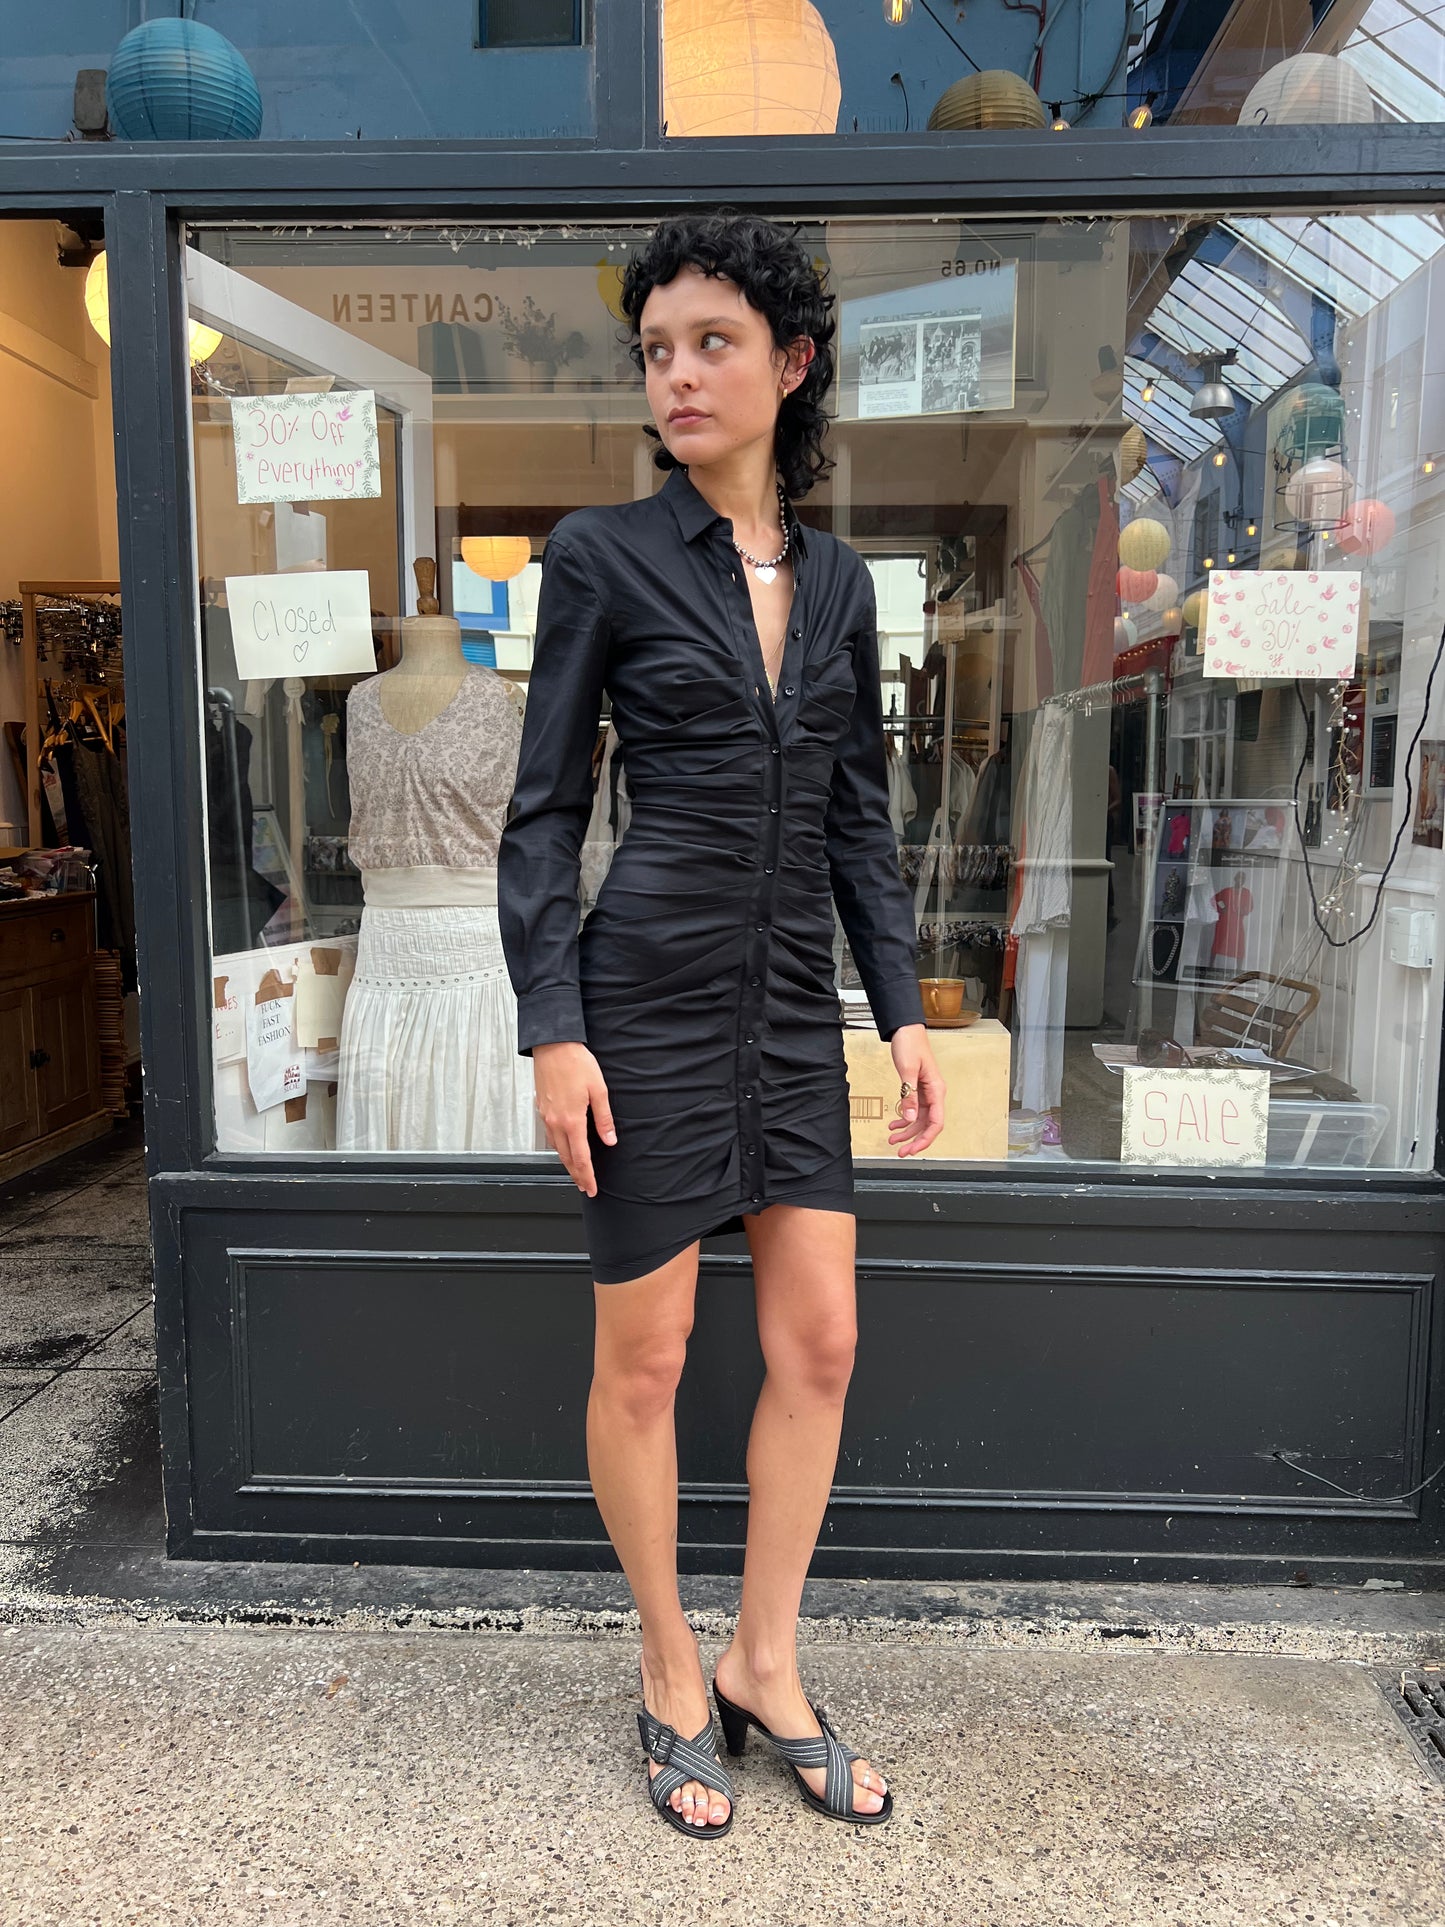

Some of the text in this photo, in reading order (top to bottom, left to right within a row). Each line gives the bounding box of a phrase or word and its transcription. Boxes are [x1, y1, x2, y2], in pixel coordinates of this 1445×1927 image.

[248, 409, 345, 448] 30% Off
[258, 457, 356, 492] everything
[1255, 582, 1316, 616] Sale
[252, 599, 337, 642] Closed
[1261, 619, 1302, 651] 30%
[258, 1026, 291, 1046] FASHION
[263, 1014, 280, 1029] FAST
